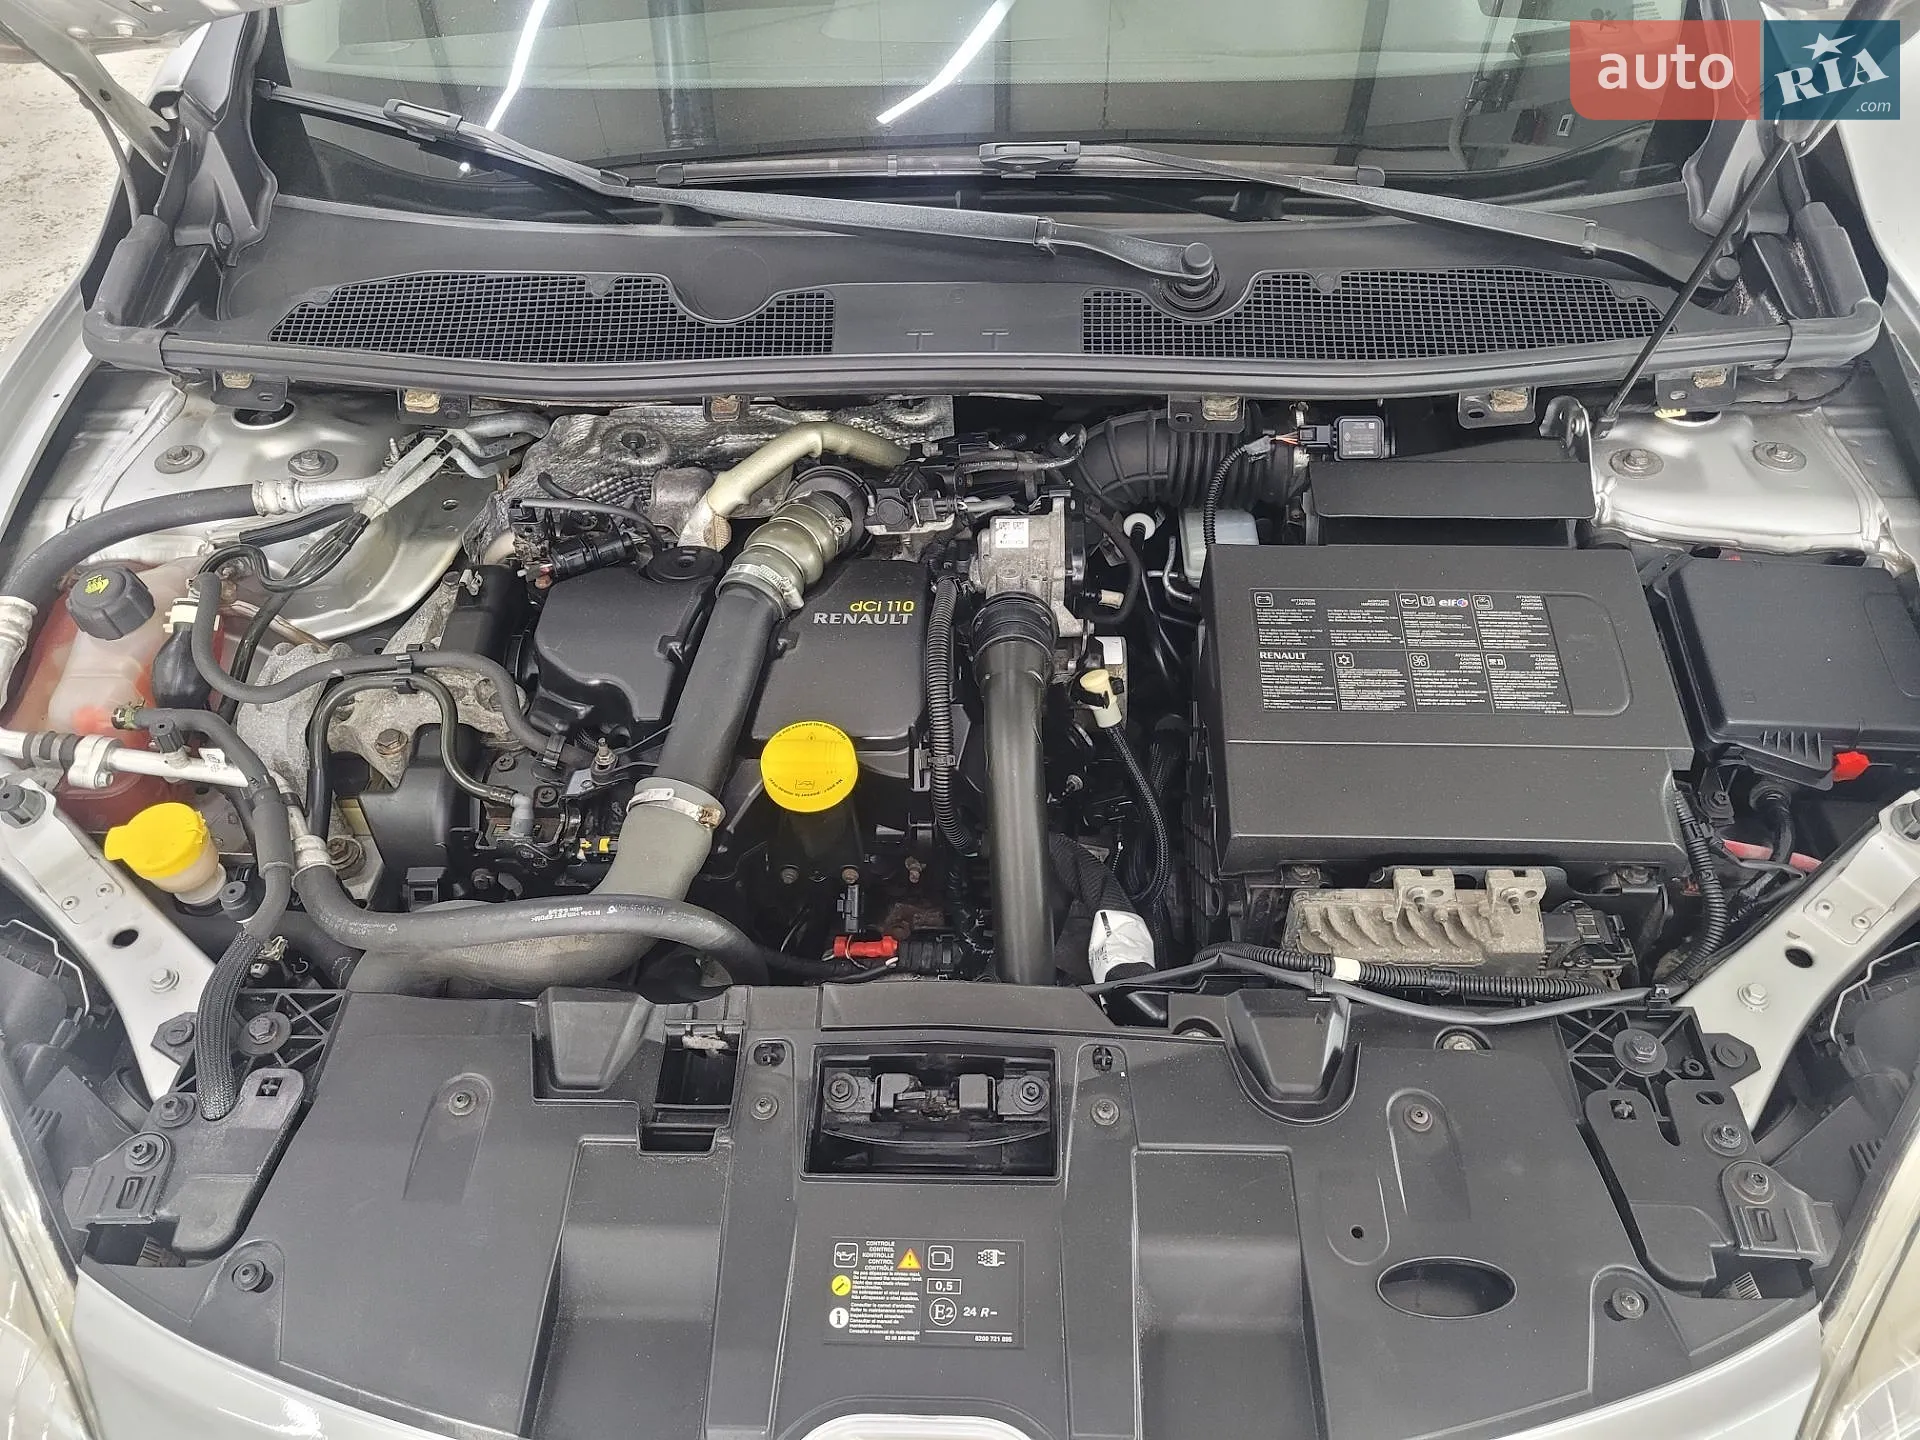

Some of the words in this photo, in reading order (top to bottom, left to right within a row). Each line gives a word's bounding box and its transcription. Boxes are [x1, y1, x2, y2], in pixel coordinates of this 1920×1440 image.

[850, 600, 882, 612] dCi
[887, 600, 915, 612] 110
[1439, 598, 1457, 607] elf
[813, 612, 913, 624] RENAULT
[1259, 652, 1307, 660] RENAULT
[935, 1281, 953, 1292] 0,5
[934, 1304, 954, 1320] E2
[963, 1306, 977, 1317] 24
